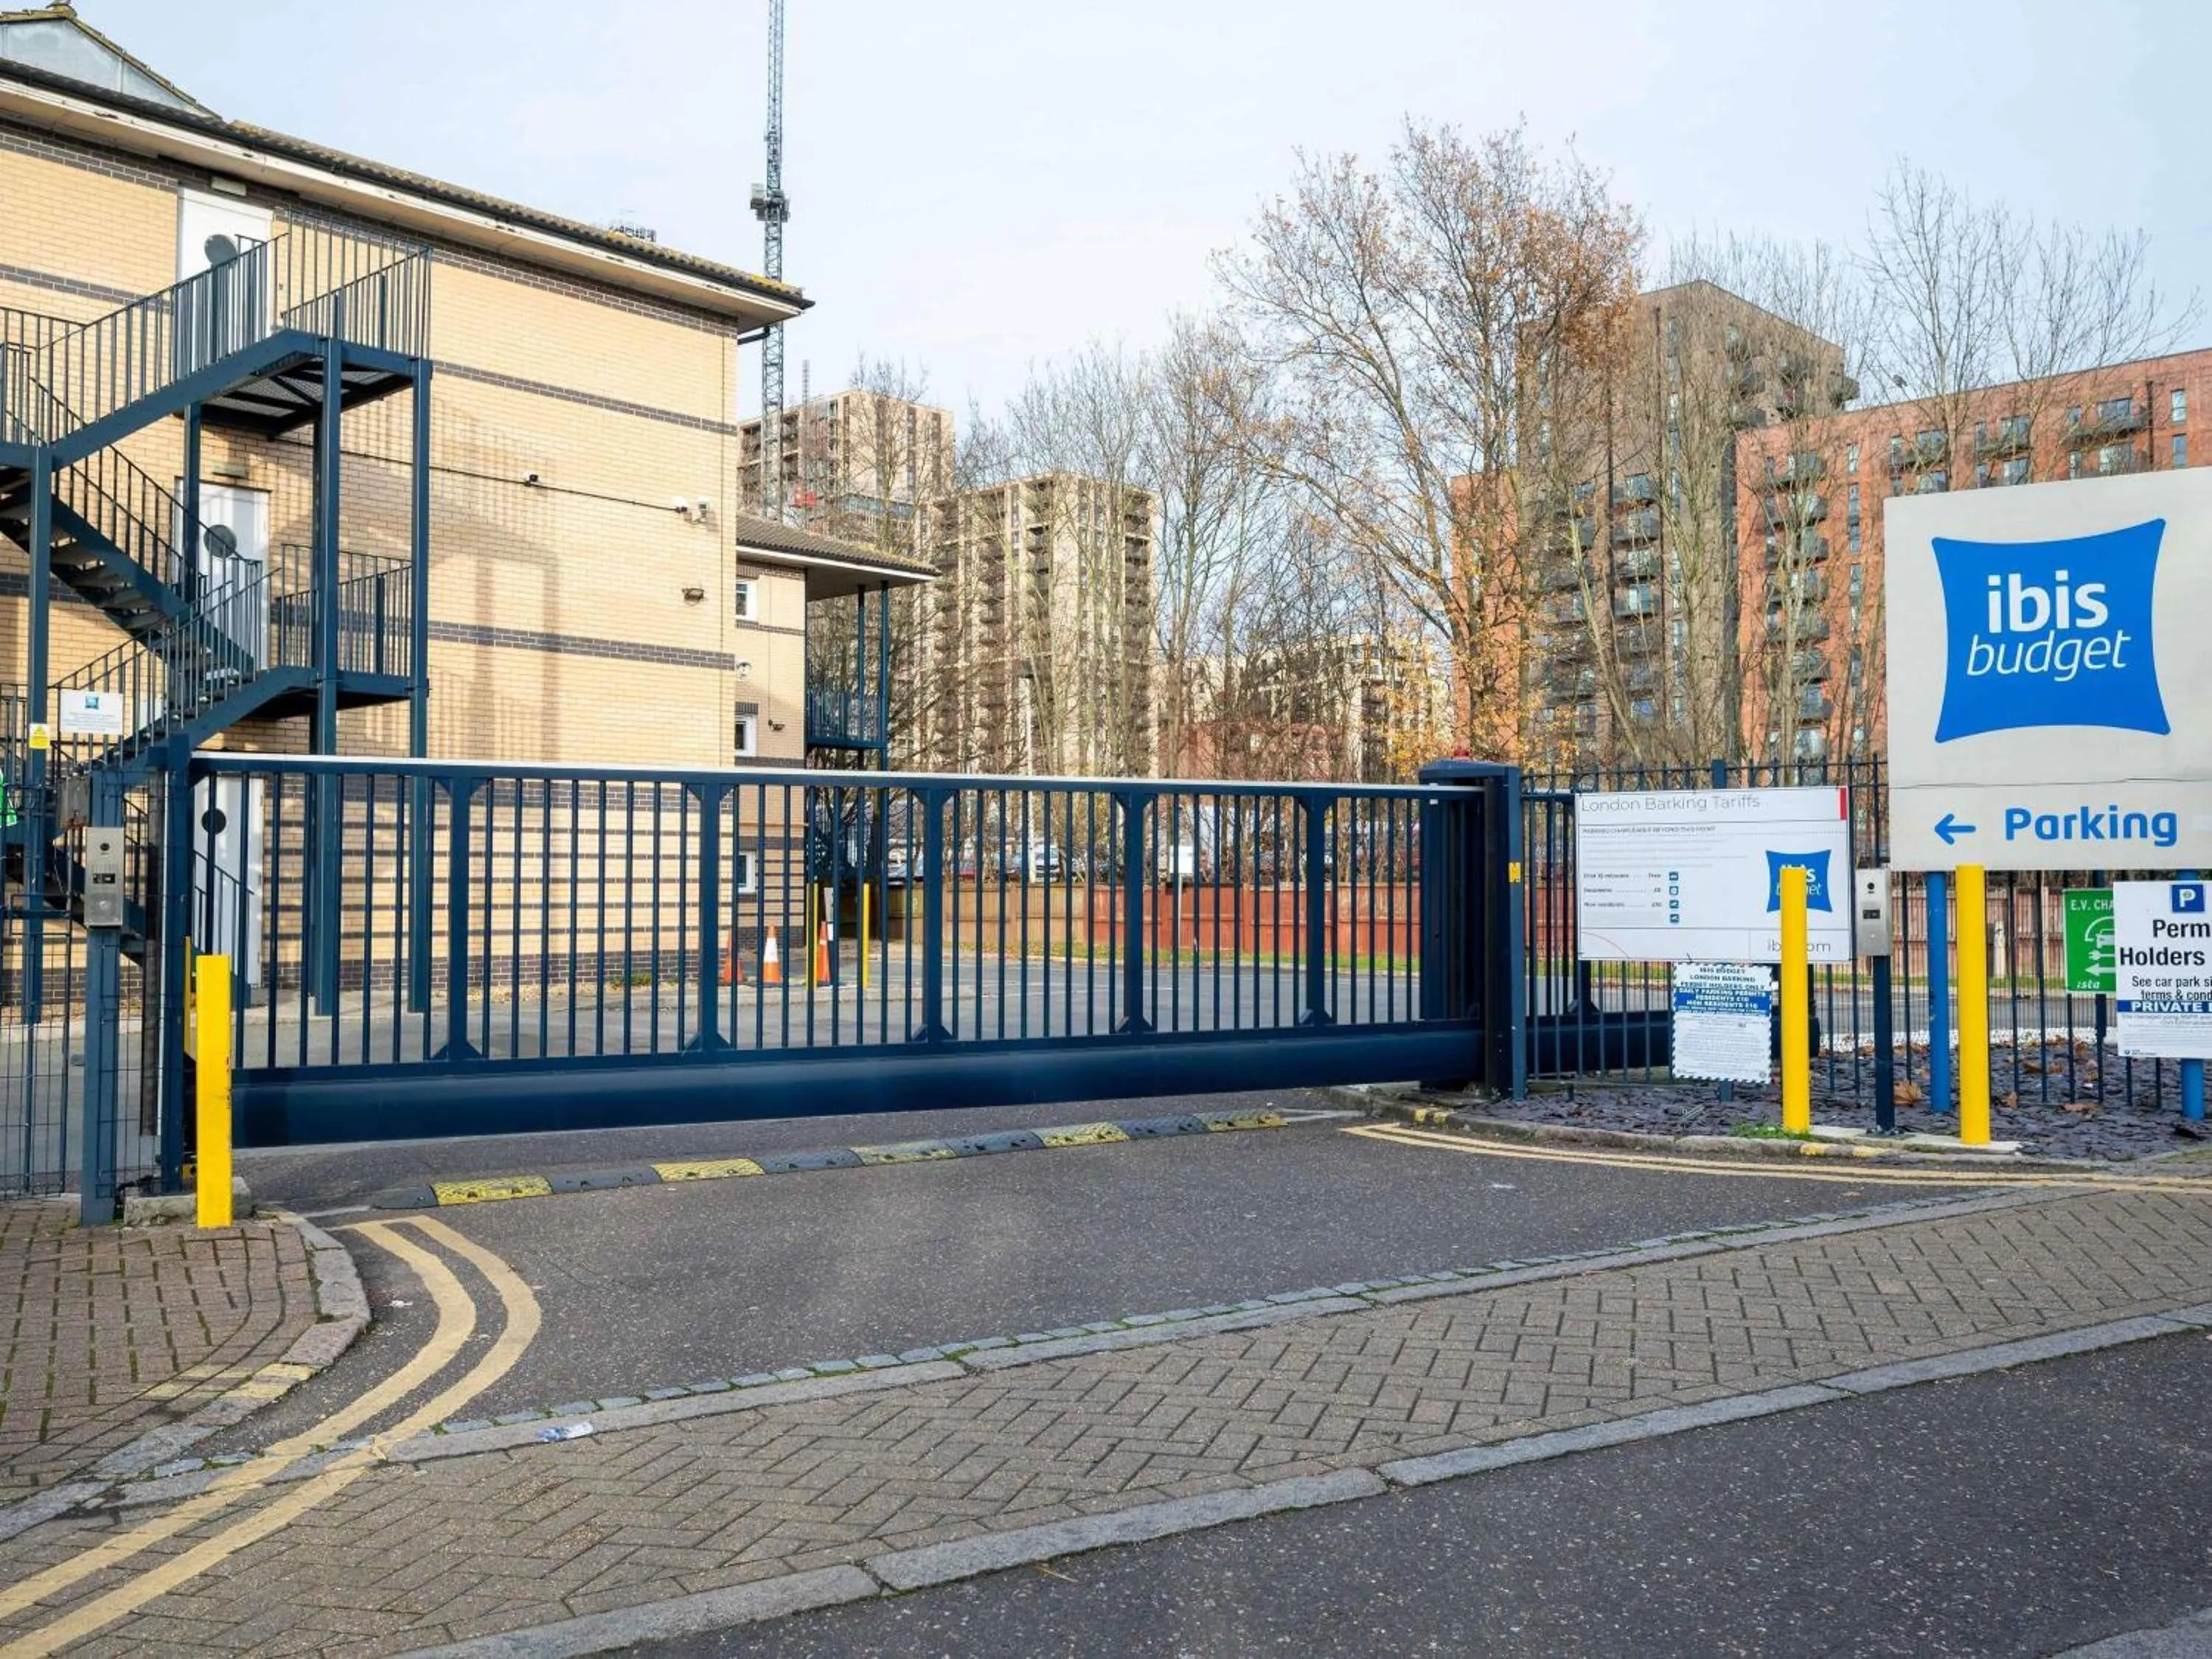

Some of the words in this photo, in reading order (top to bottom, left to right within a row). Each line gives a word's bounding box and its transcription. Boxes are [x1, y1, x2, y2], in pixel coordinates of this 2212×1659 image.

[1987, 569, 2108, 633] ibis
[1966, 630, 2132, 682] budget
[1582, 797, 1641, 812] London
[1645, 796, 1707, 812] Barking
[1711, 794, 1761, 810] Tariffs
[2005, 804, 2178, 847] Parking
[2070, 899, 2091, 911] E.V.
[2180, 888, 2196, 907] P
[2152, 919, 2211, 938] Perm
[2120, 946, 2205, 966] Holders
[2132, 975, 2152, 987] See
[2155, 978, 2172, 987] car
[2176, 975, 2201, 990] park
[2141, 990, 2172, 1001] terms
[2175, 989, 2183, 1001] &
[2131, 1001, 2203, 1012] PRIVATE
